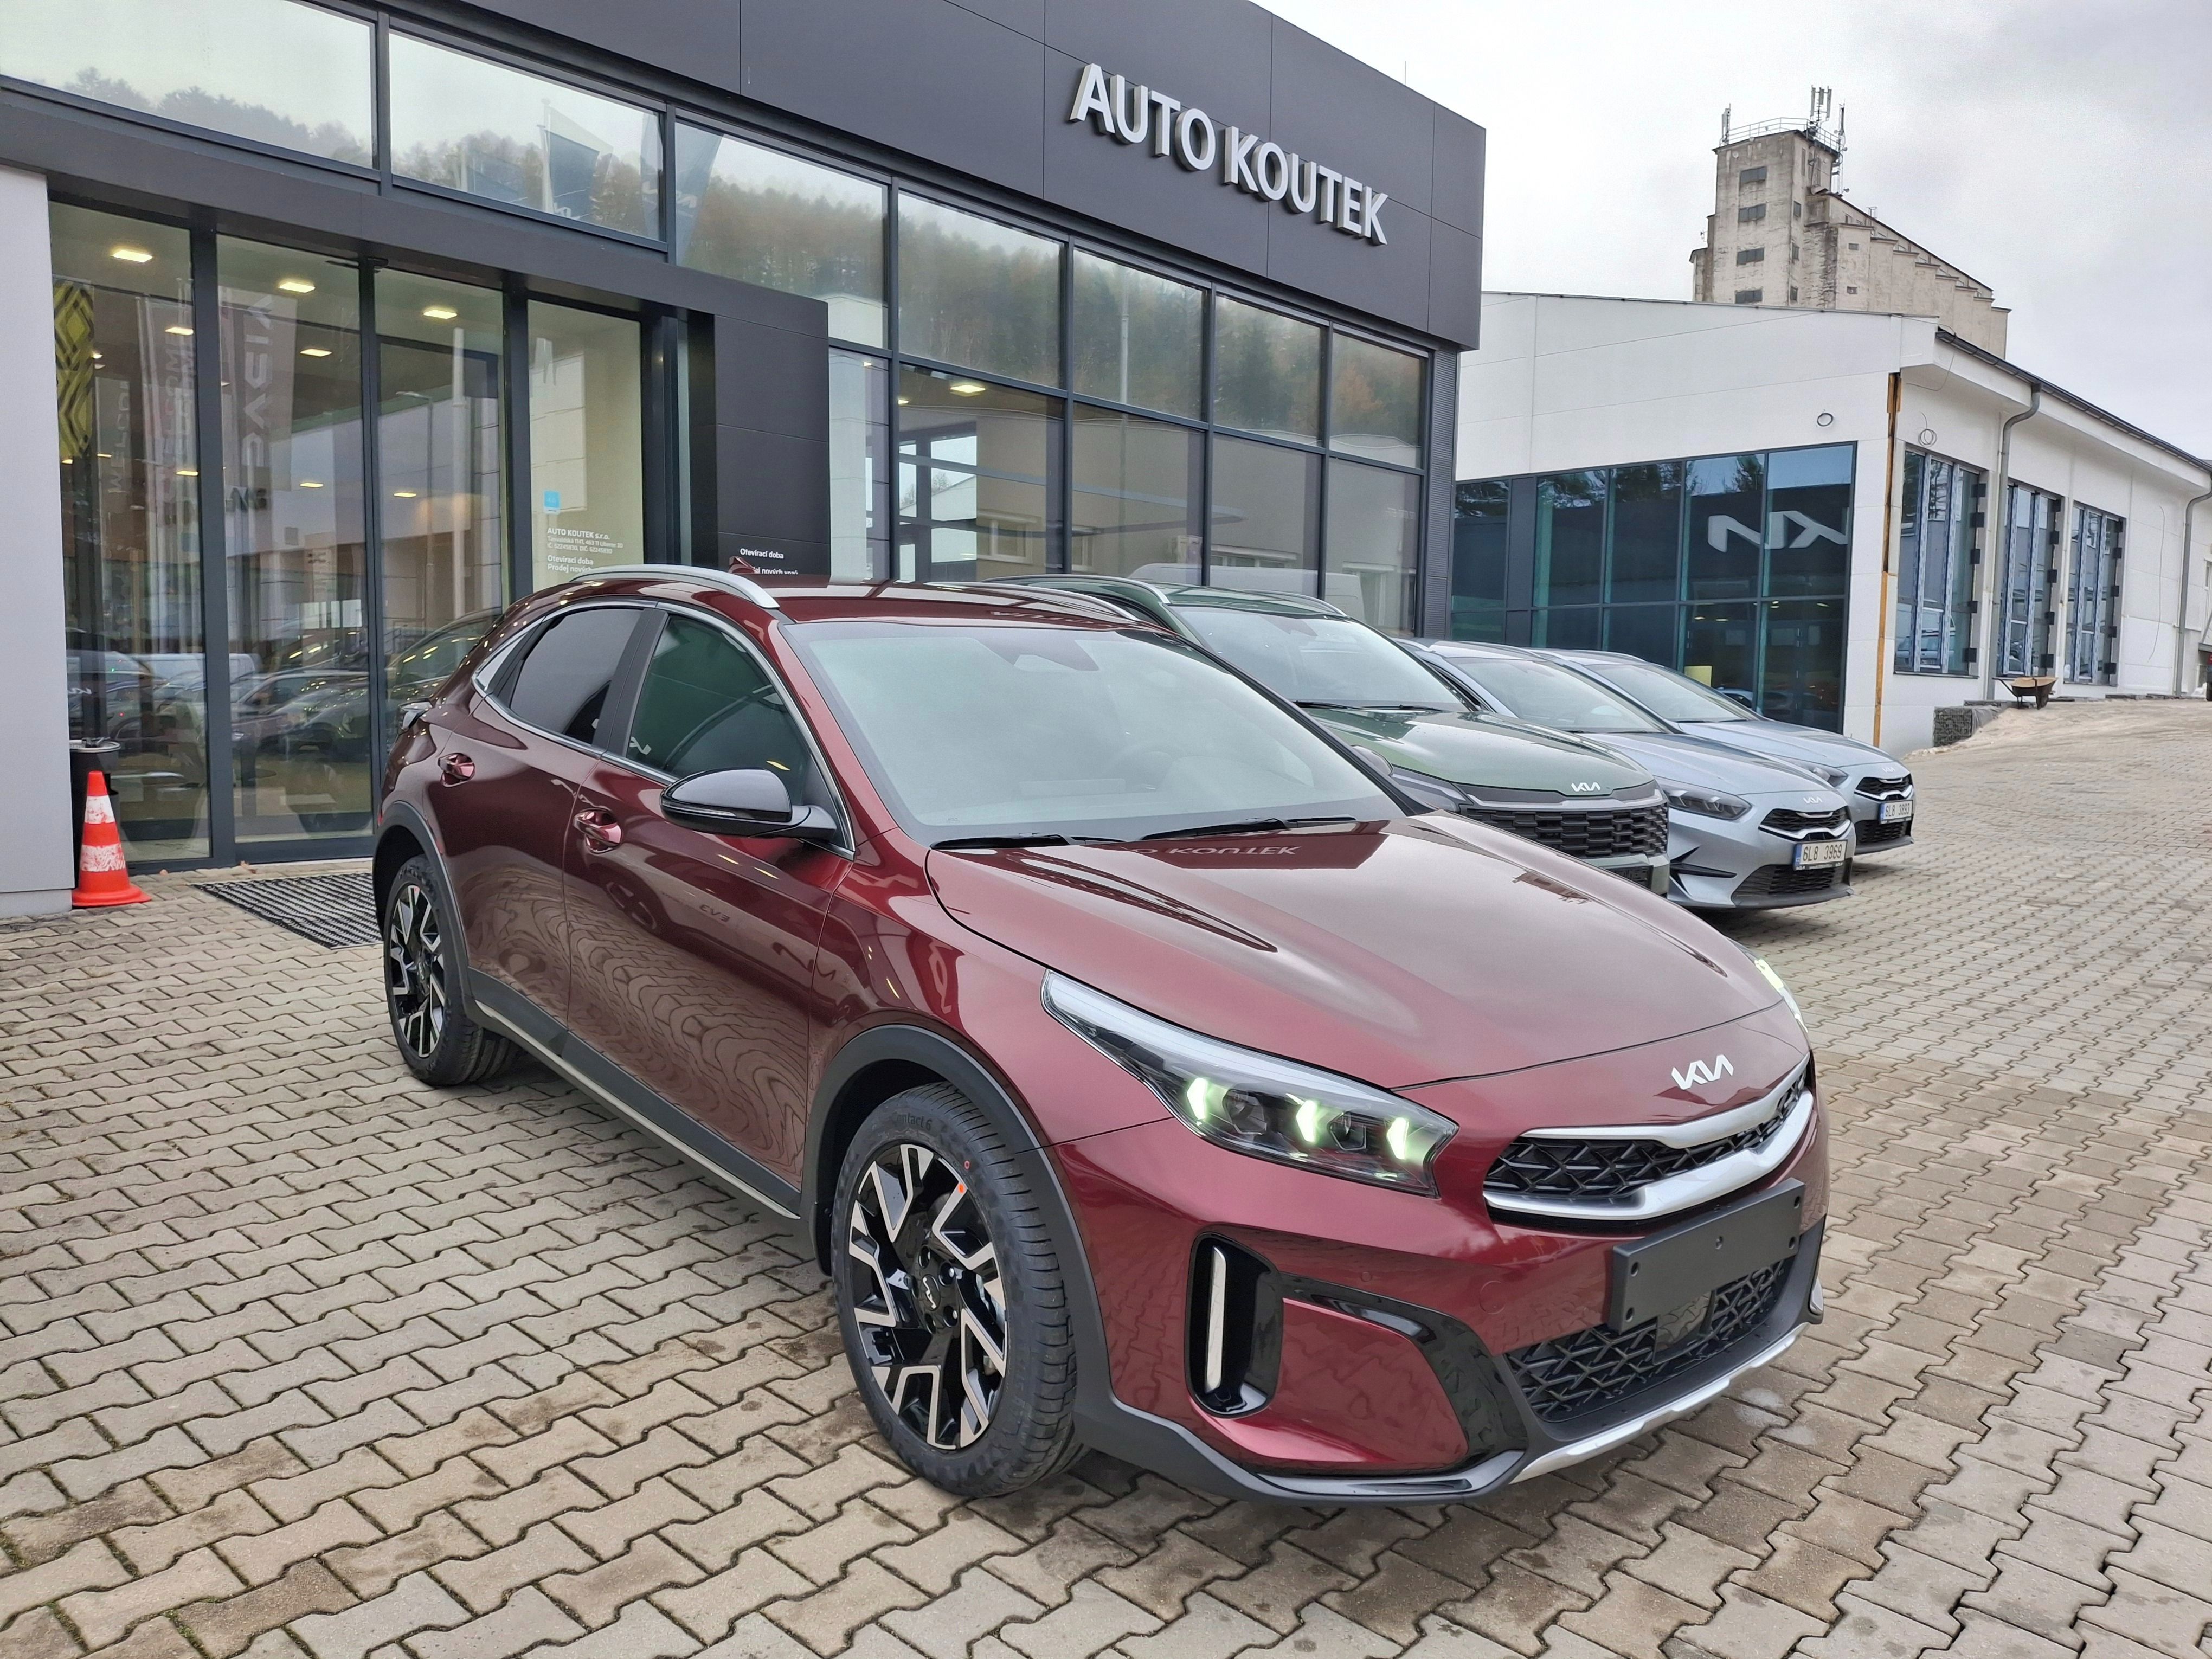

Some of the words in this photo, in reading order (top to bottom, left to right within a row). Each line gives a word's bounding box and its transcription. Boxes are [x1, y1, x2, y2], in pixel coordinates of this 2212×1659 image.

[1069, 63, 1216, 171] AUTO
[1224, 125, 1388, 246] KOUTEK
[567, 529, 594, 538] KOUTEK
[740, 548, 768, 557] Otevírací
[768, 551, 784, 559] doba
[548, 555, 576, 564] Otevírací
[577, 557, 594, 565] doba
[548, 564, 569, 574] Prodej
[1571, 782, 1601, 792] KIA
[1803, 846, 1819, 861] 6L8
[1823, 844, 1842, 860] 3969
[1671, 1054, 1734, 1090] KIA
[925, 1118, 933, 1131] 6
[923, 1276, 937, 1309] KIA
